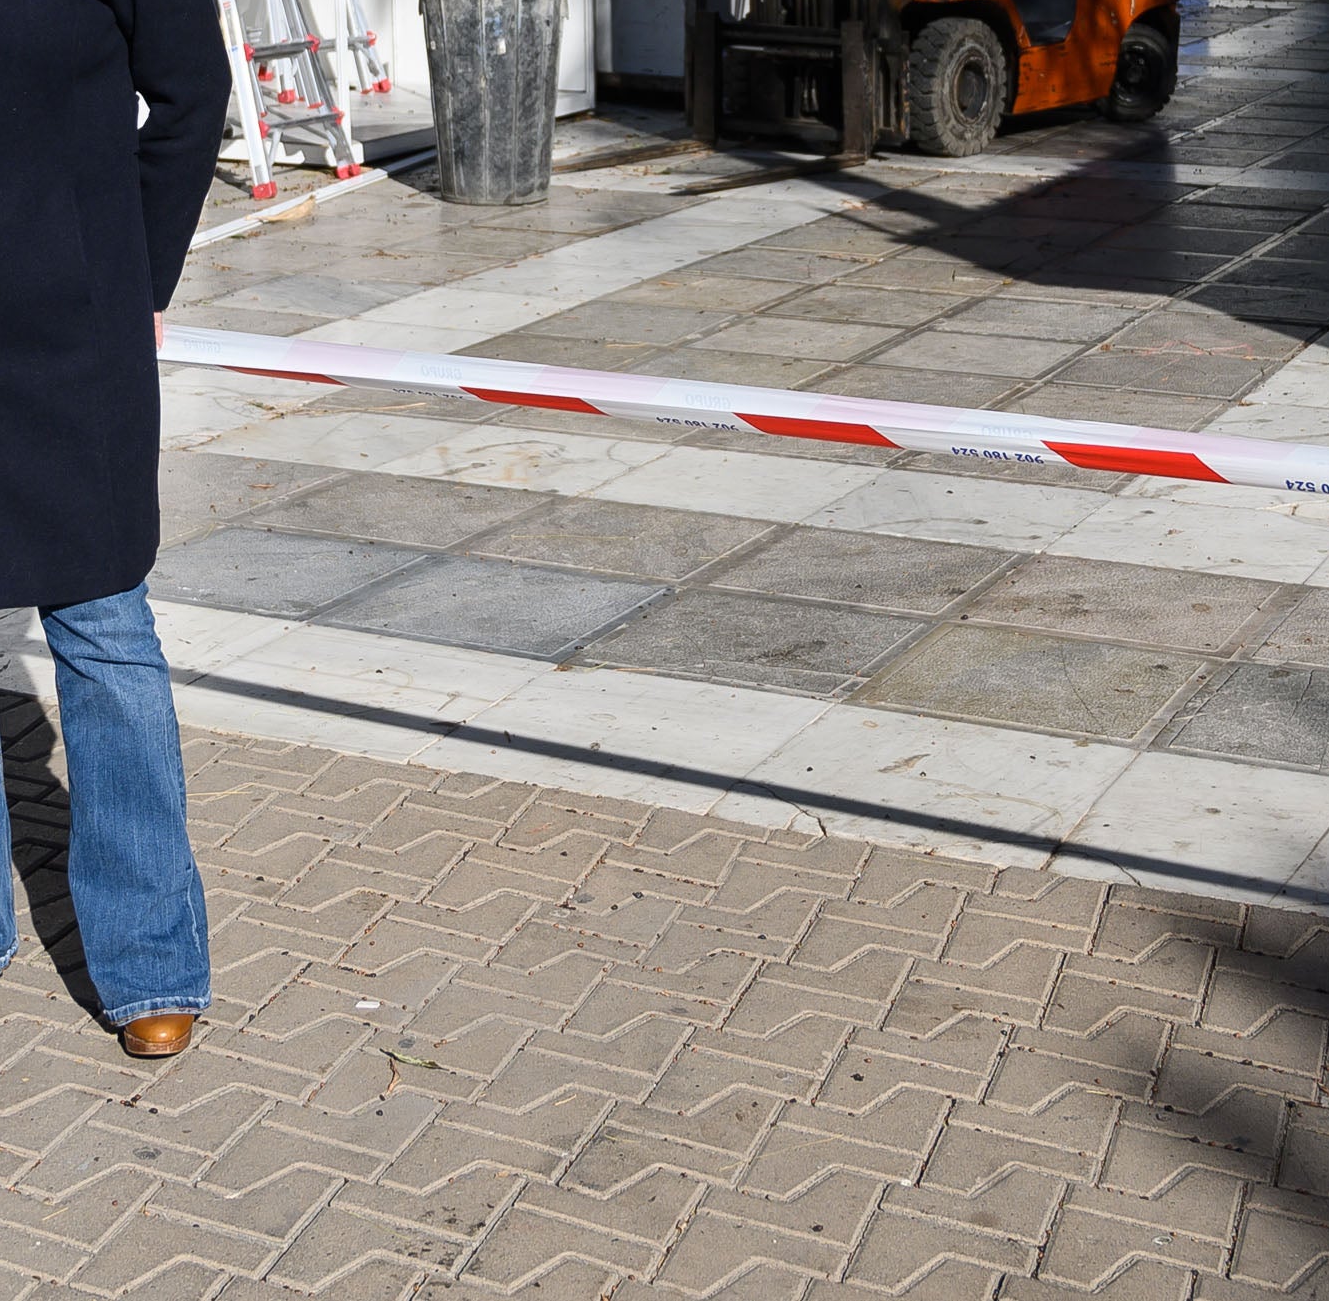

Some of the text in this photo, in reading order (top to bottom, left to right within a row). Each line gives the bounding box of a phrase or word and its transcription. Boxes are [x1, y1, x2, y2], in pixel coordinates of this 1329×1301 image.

[952, 446, 1044, 465] 902 180 524
[1285, 479, 1316, 492] 524
